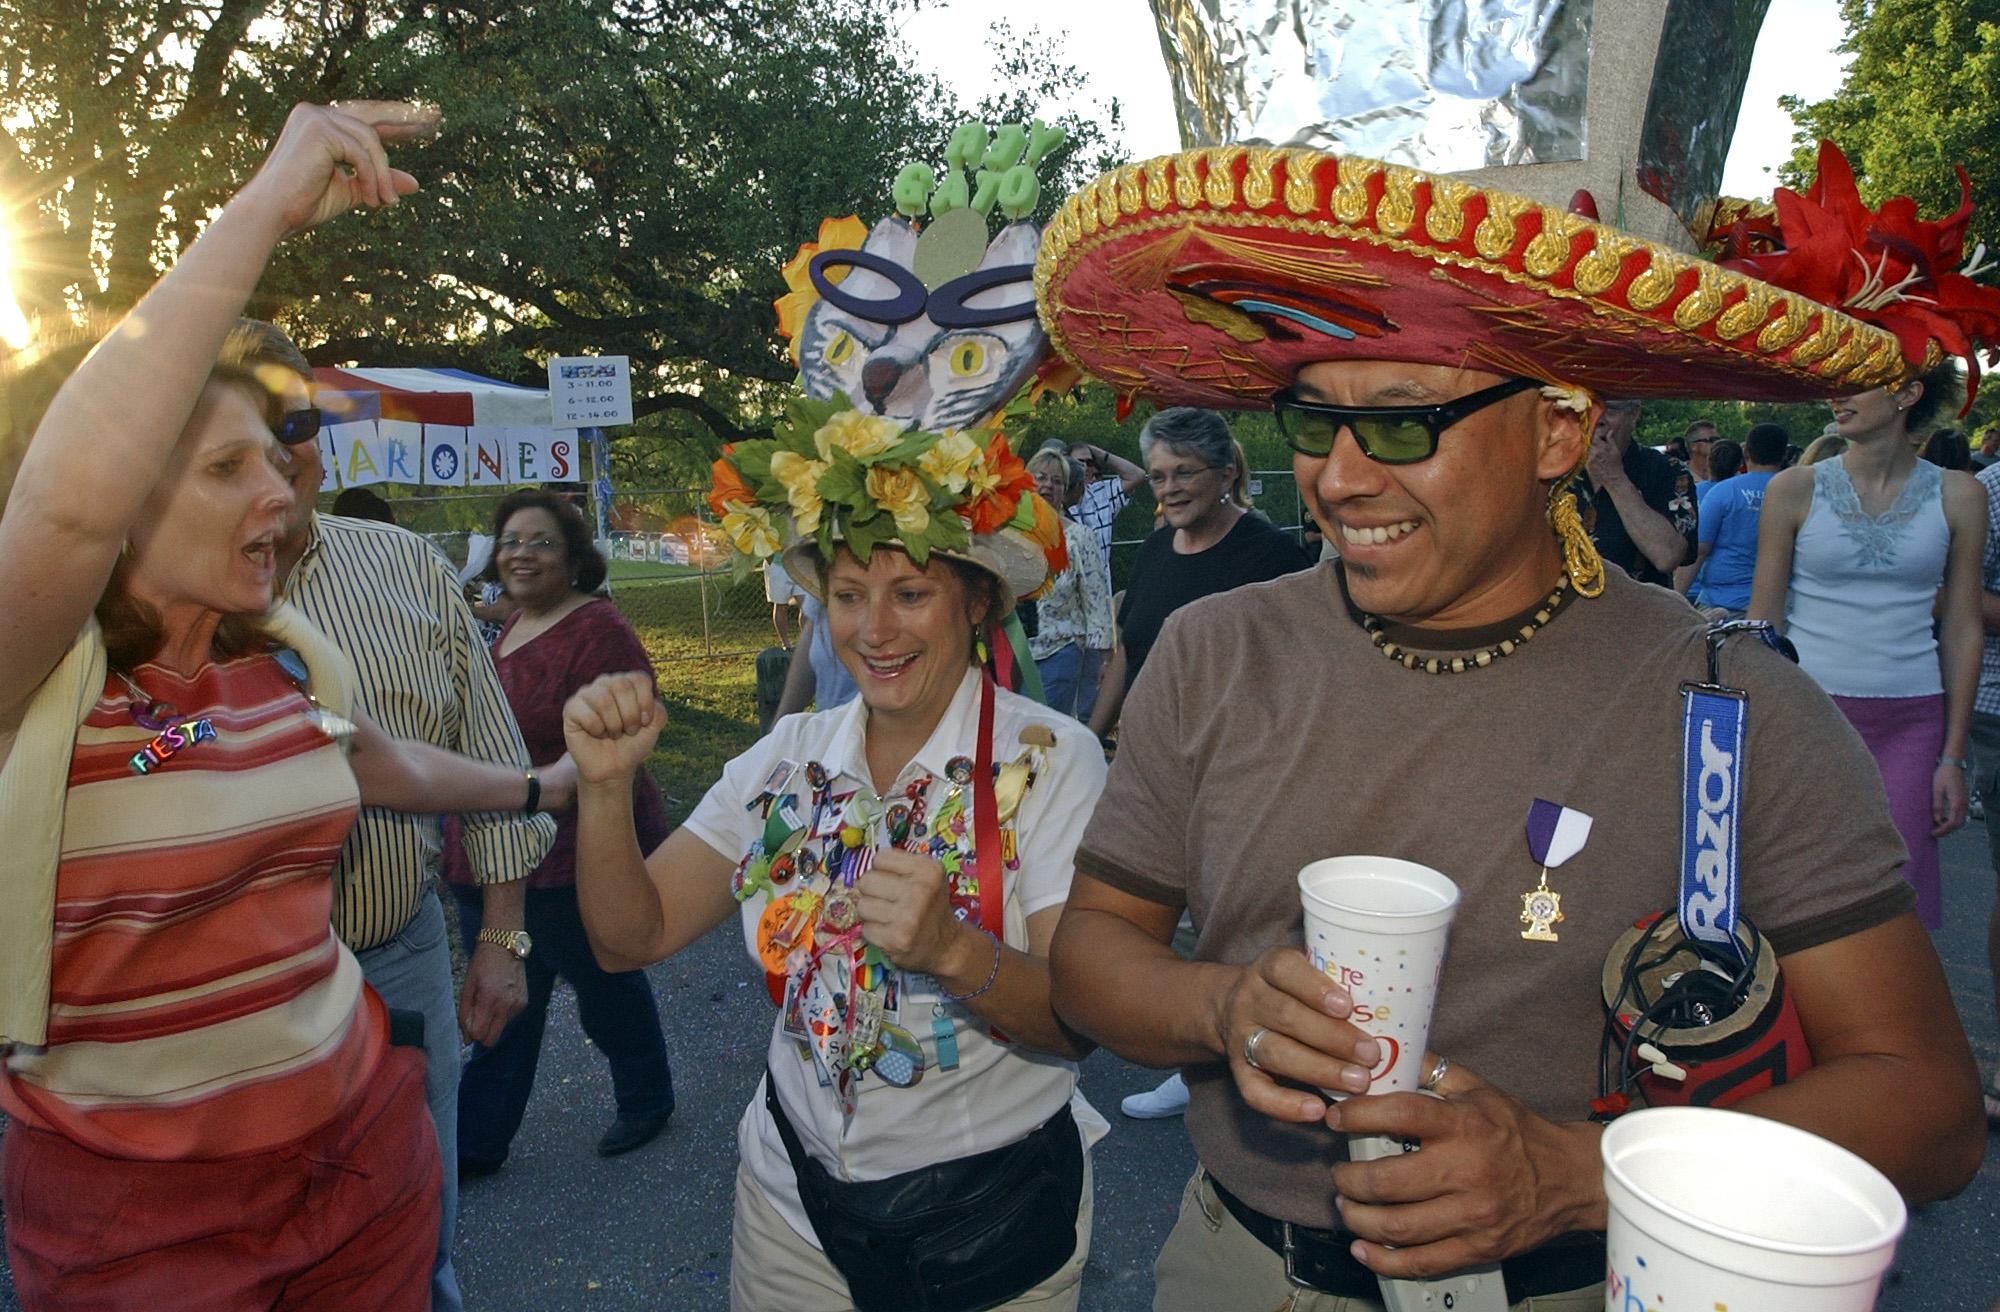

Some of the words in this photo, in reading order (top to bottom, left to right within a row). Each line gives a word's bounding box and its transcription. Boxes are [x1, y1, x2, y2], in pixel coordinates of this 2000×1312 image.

[892, 161, 1041, 220] GATO
[320, 437, 571, 487] ARONES
[132, 719, 217, 774] FIESTA
[1687, 719, 1734, 944] Razor
